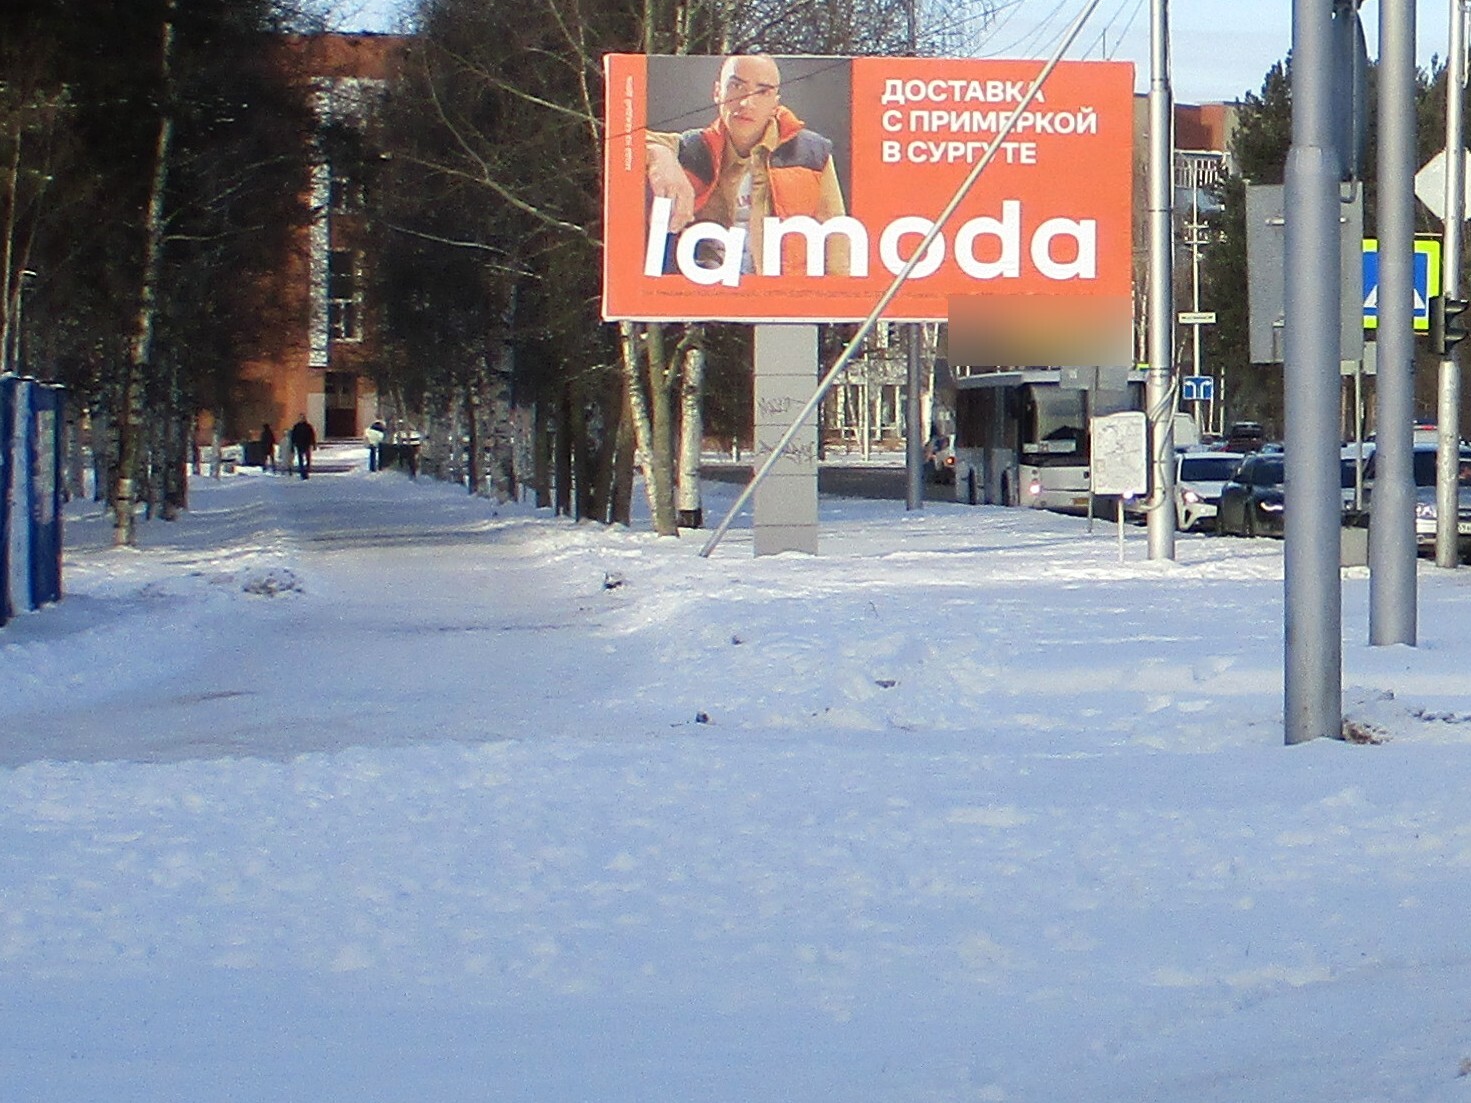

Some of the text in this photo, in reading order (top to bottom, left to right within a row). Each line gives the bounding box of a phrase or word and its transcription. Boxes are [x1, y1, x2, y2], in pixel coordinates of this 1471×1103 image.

[882, 107, 1097, 134] С ПРИМЕРКОЙ
[882, 141, 901, 163] В
[644, 197, 1097, 287] lamoda
